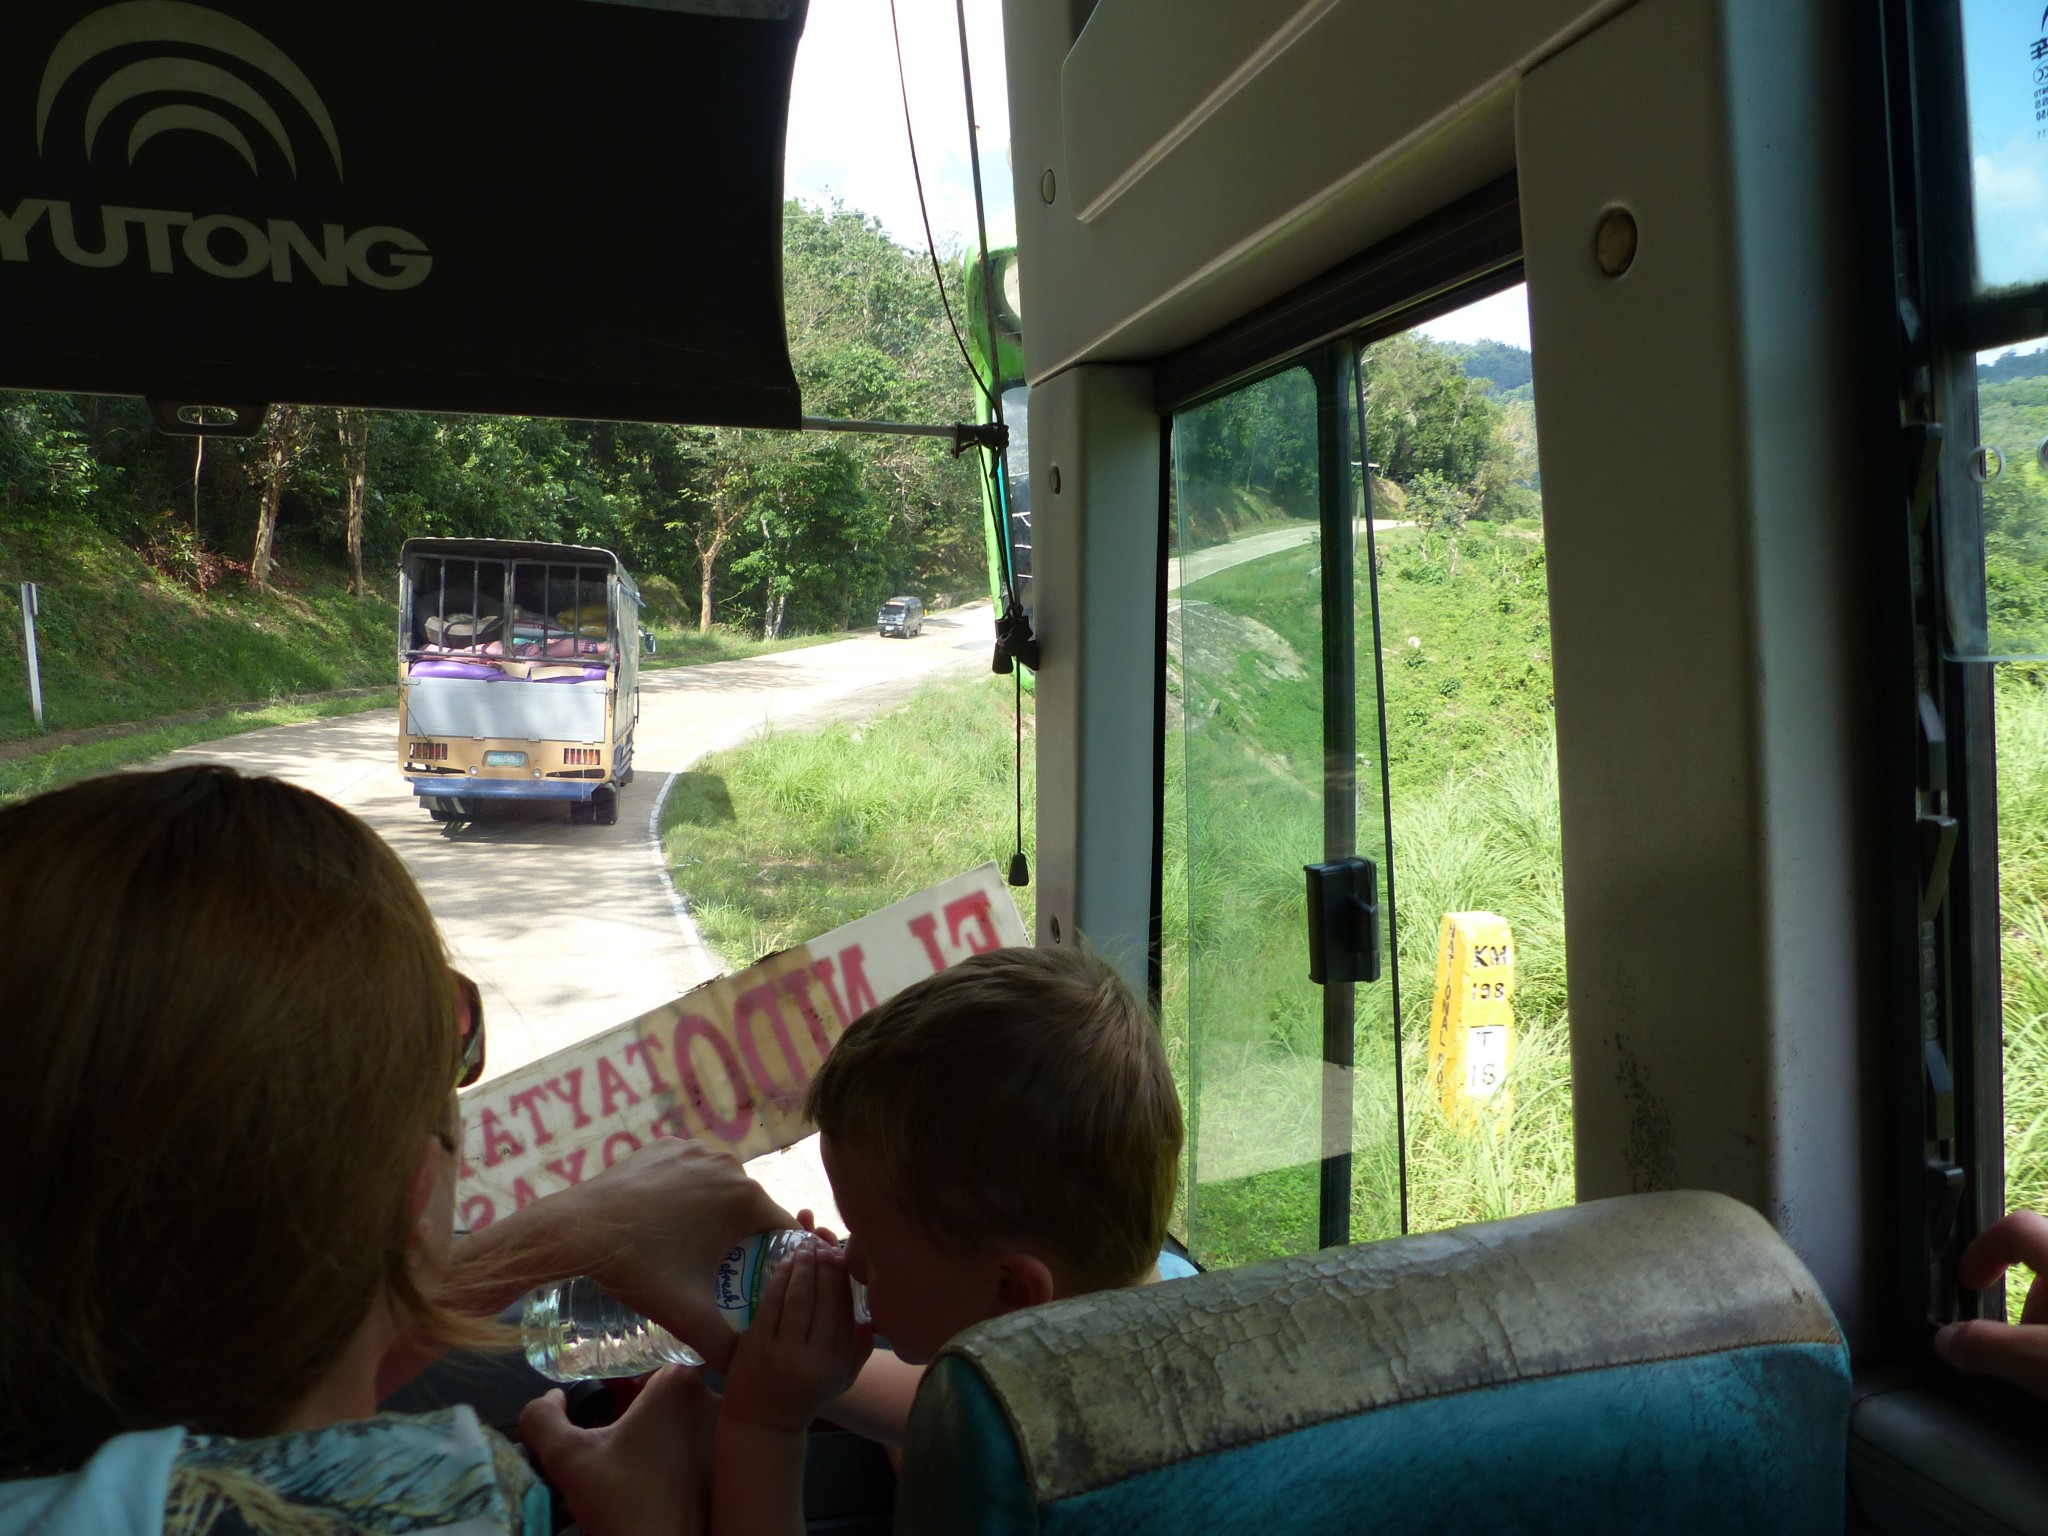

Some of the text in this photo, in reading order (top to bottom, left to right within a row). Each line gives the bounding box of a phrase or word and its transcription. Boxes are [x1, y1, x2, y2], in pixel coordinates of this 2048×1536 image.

[0, 198, 432, 290] YUTONG
[1474, 945, 1507, 967] KM
[1476, 1030, 1493, 1047] T
